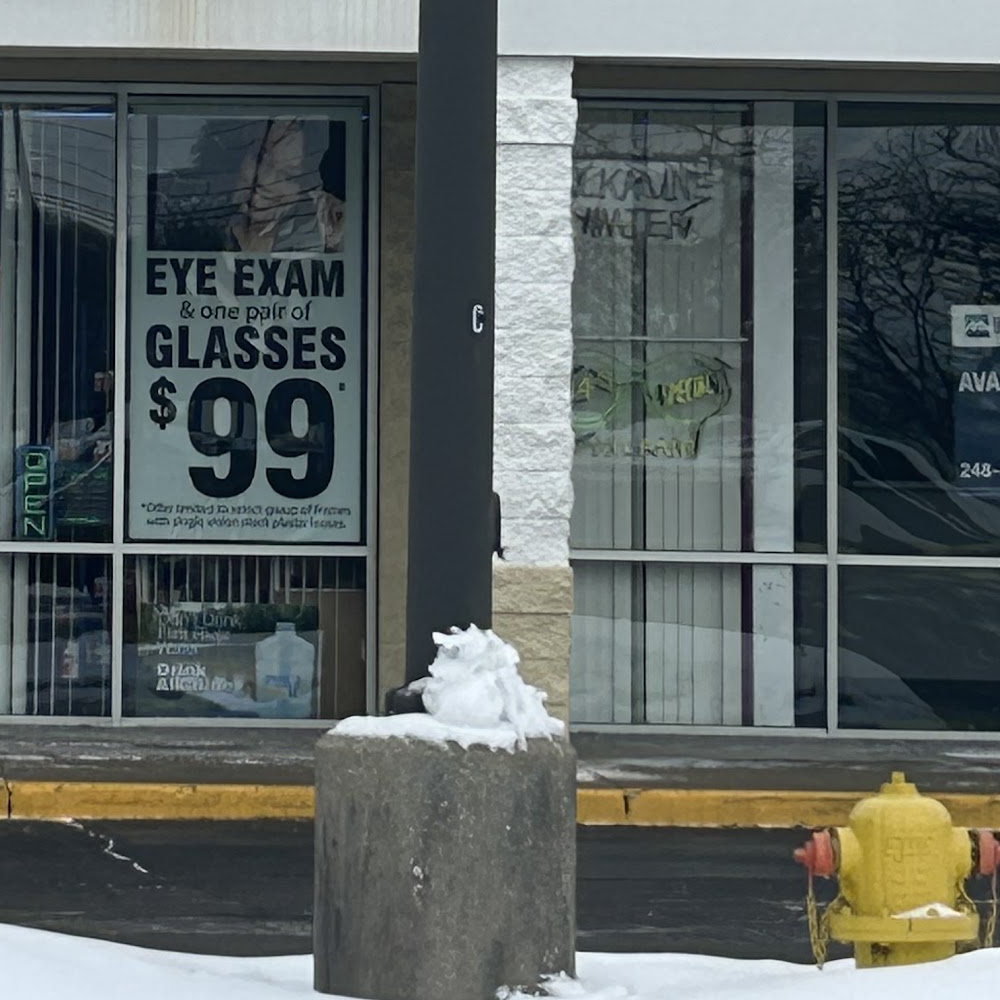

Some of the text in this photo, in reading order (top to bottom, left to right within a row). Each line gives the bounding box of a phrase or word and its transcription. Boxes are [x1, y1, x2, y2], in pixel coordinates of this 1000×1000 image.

[146, 257, 345, 298] EYE EXAM
[179, 300, 313, 326] & one pair of
[146, 324, 347, 371] GLASSES
[23, 451, 49, 538] OPEN
